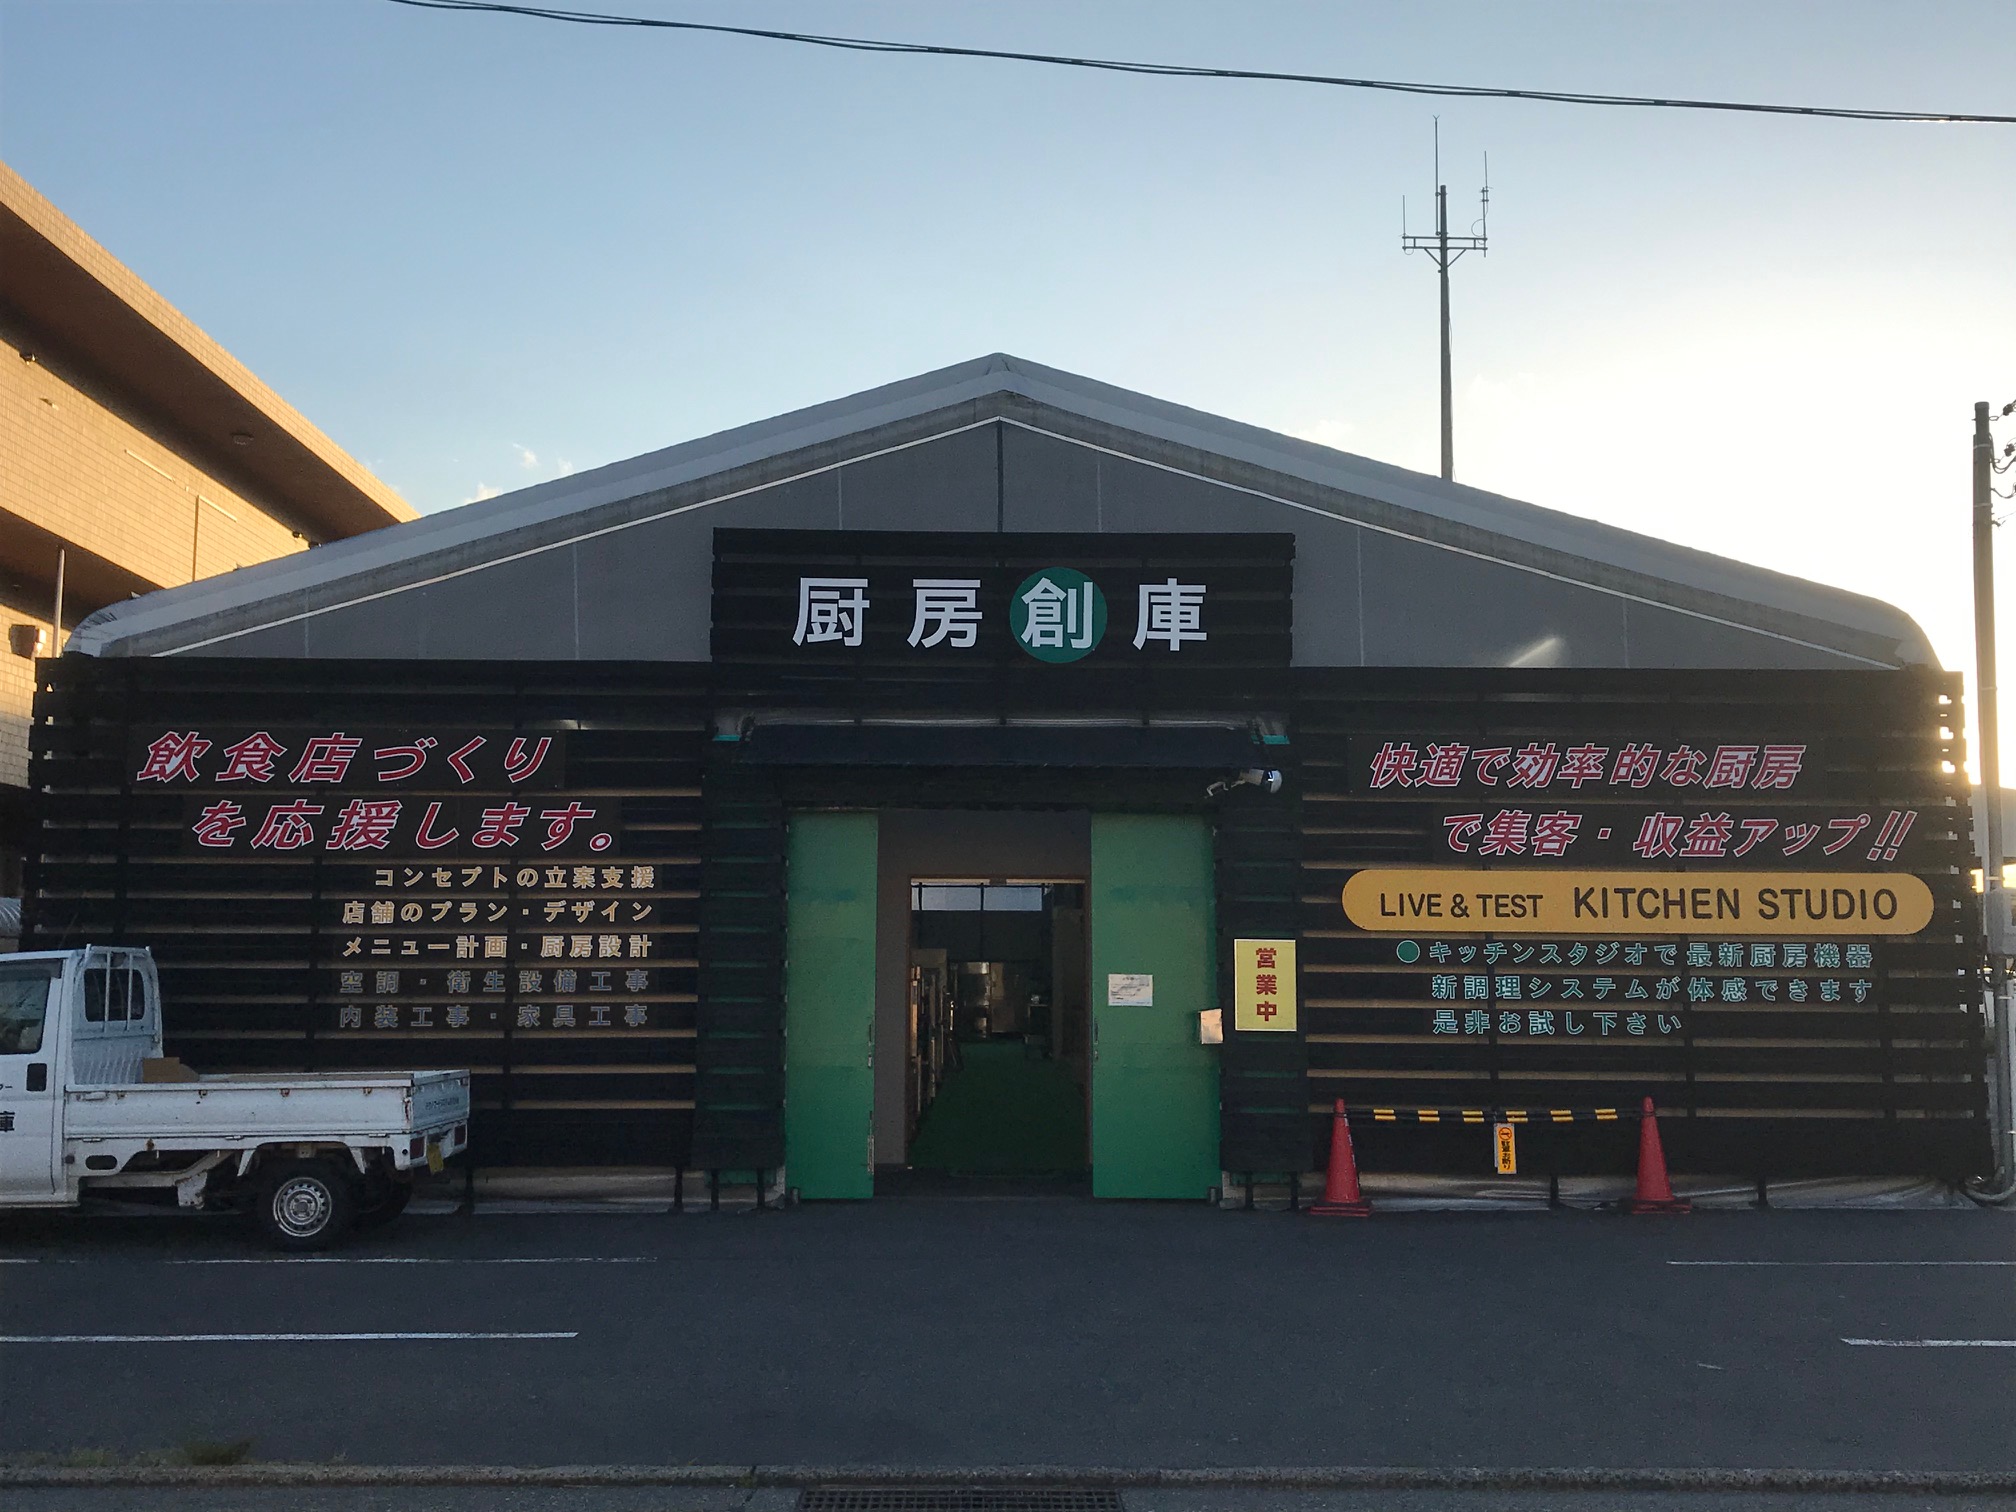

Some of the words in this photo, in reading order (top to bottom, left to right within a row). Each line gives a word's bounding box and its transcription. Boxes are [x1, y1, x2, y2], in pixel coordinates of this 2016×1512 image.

[792, 577, 1208, 651] 厨房創庫
[137, 731, 552, 783] 飲食店づくり
[1370, 743, 1804, 789] 快適で効率的な厨房
[192, 799, 612, 851] を応援します。
[375, 866, 655, 889] コンセプトの立案支援
[342, 900, 653, 924] 店舗のプラン・デザイン
[1380, 893, 1442, 918] LIVE
[1451, 896, 1469, 918] &
[1476, 894, 1543, 919] TEST
[1574, 887, 1741, 920] KITCHEN
[1758, 888, 1898, 921] STUDIO
[342, 934, 652, 958] メニュー計画・厨房設計
[1429, 941, 1874, 969] キッチンスタジオで最新厨房機器
[339, 969, 649, 994] 空調・衛生設備工事
[1256, 947, 1277, 1022] 営業中
[1431, 974, 1873, 1004] 新調理システムが体感できます
[339, 1004, 648, 1028] 内装工事・家具工事
[1433, 1009, 1682, 1035] 是非お試し下さい
